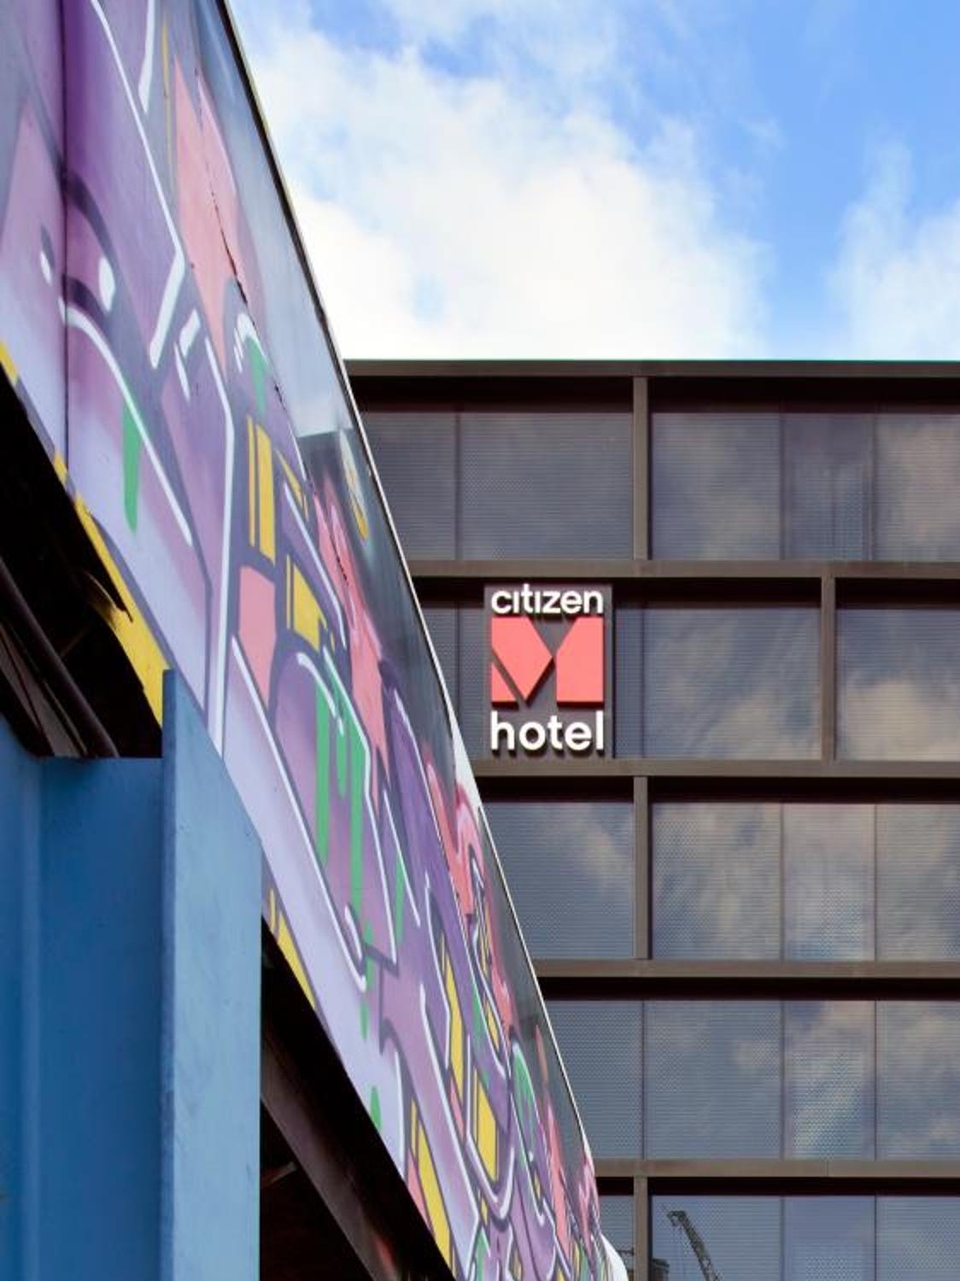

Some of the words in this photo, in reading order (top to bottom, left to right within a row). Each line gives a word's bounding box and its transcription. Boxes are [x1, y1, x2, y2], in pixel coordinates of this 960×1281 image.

[491, 583, 604, 614] citizen
[491, 616, 604, 704] M
[490, 710, 604, 751] hotel
